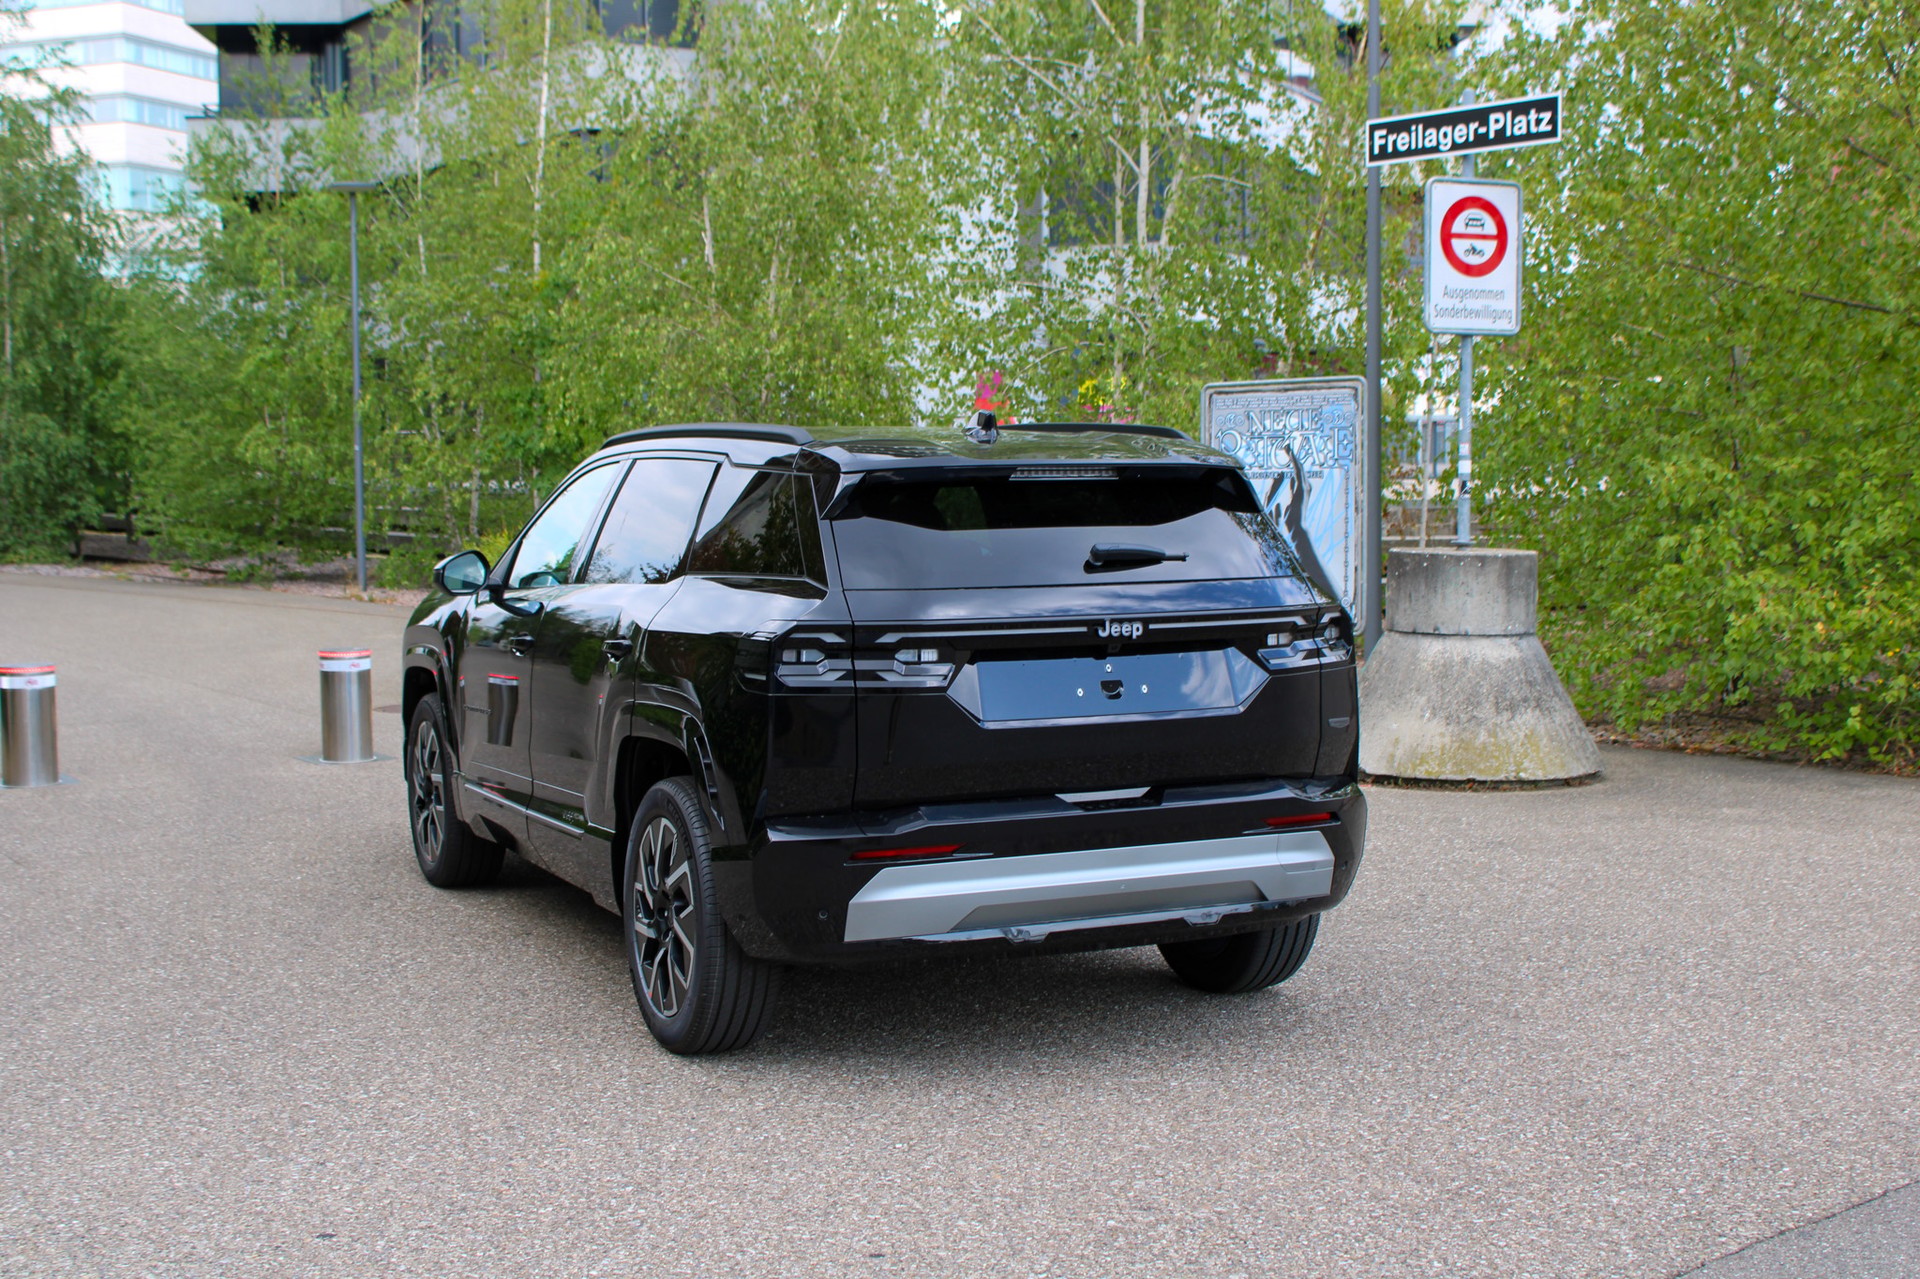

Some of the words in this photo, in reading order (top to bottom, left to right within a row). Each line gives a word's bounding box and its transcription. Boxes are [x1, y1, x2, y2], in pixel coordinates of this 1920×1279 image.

[1373, 108, 1553, 155] Freilager-Platz
[1442, 284, 1505, 303] Ausgenommen
[1433, 303, 1513, 324] Sonderbewilligung
[1097, 617, 1143, 640] Jeep
